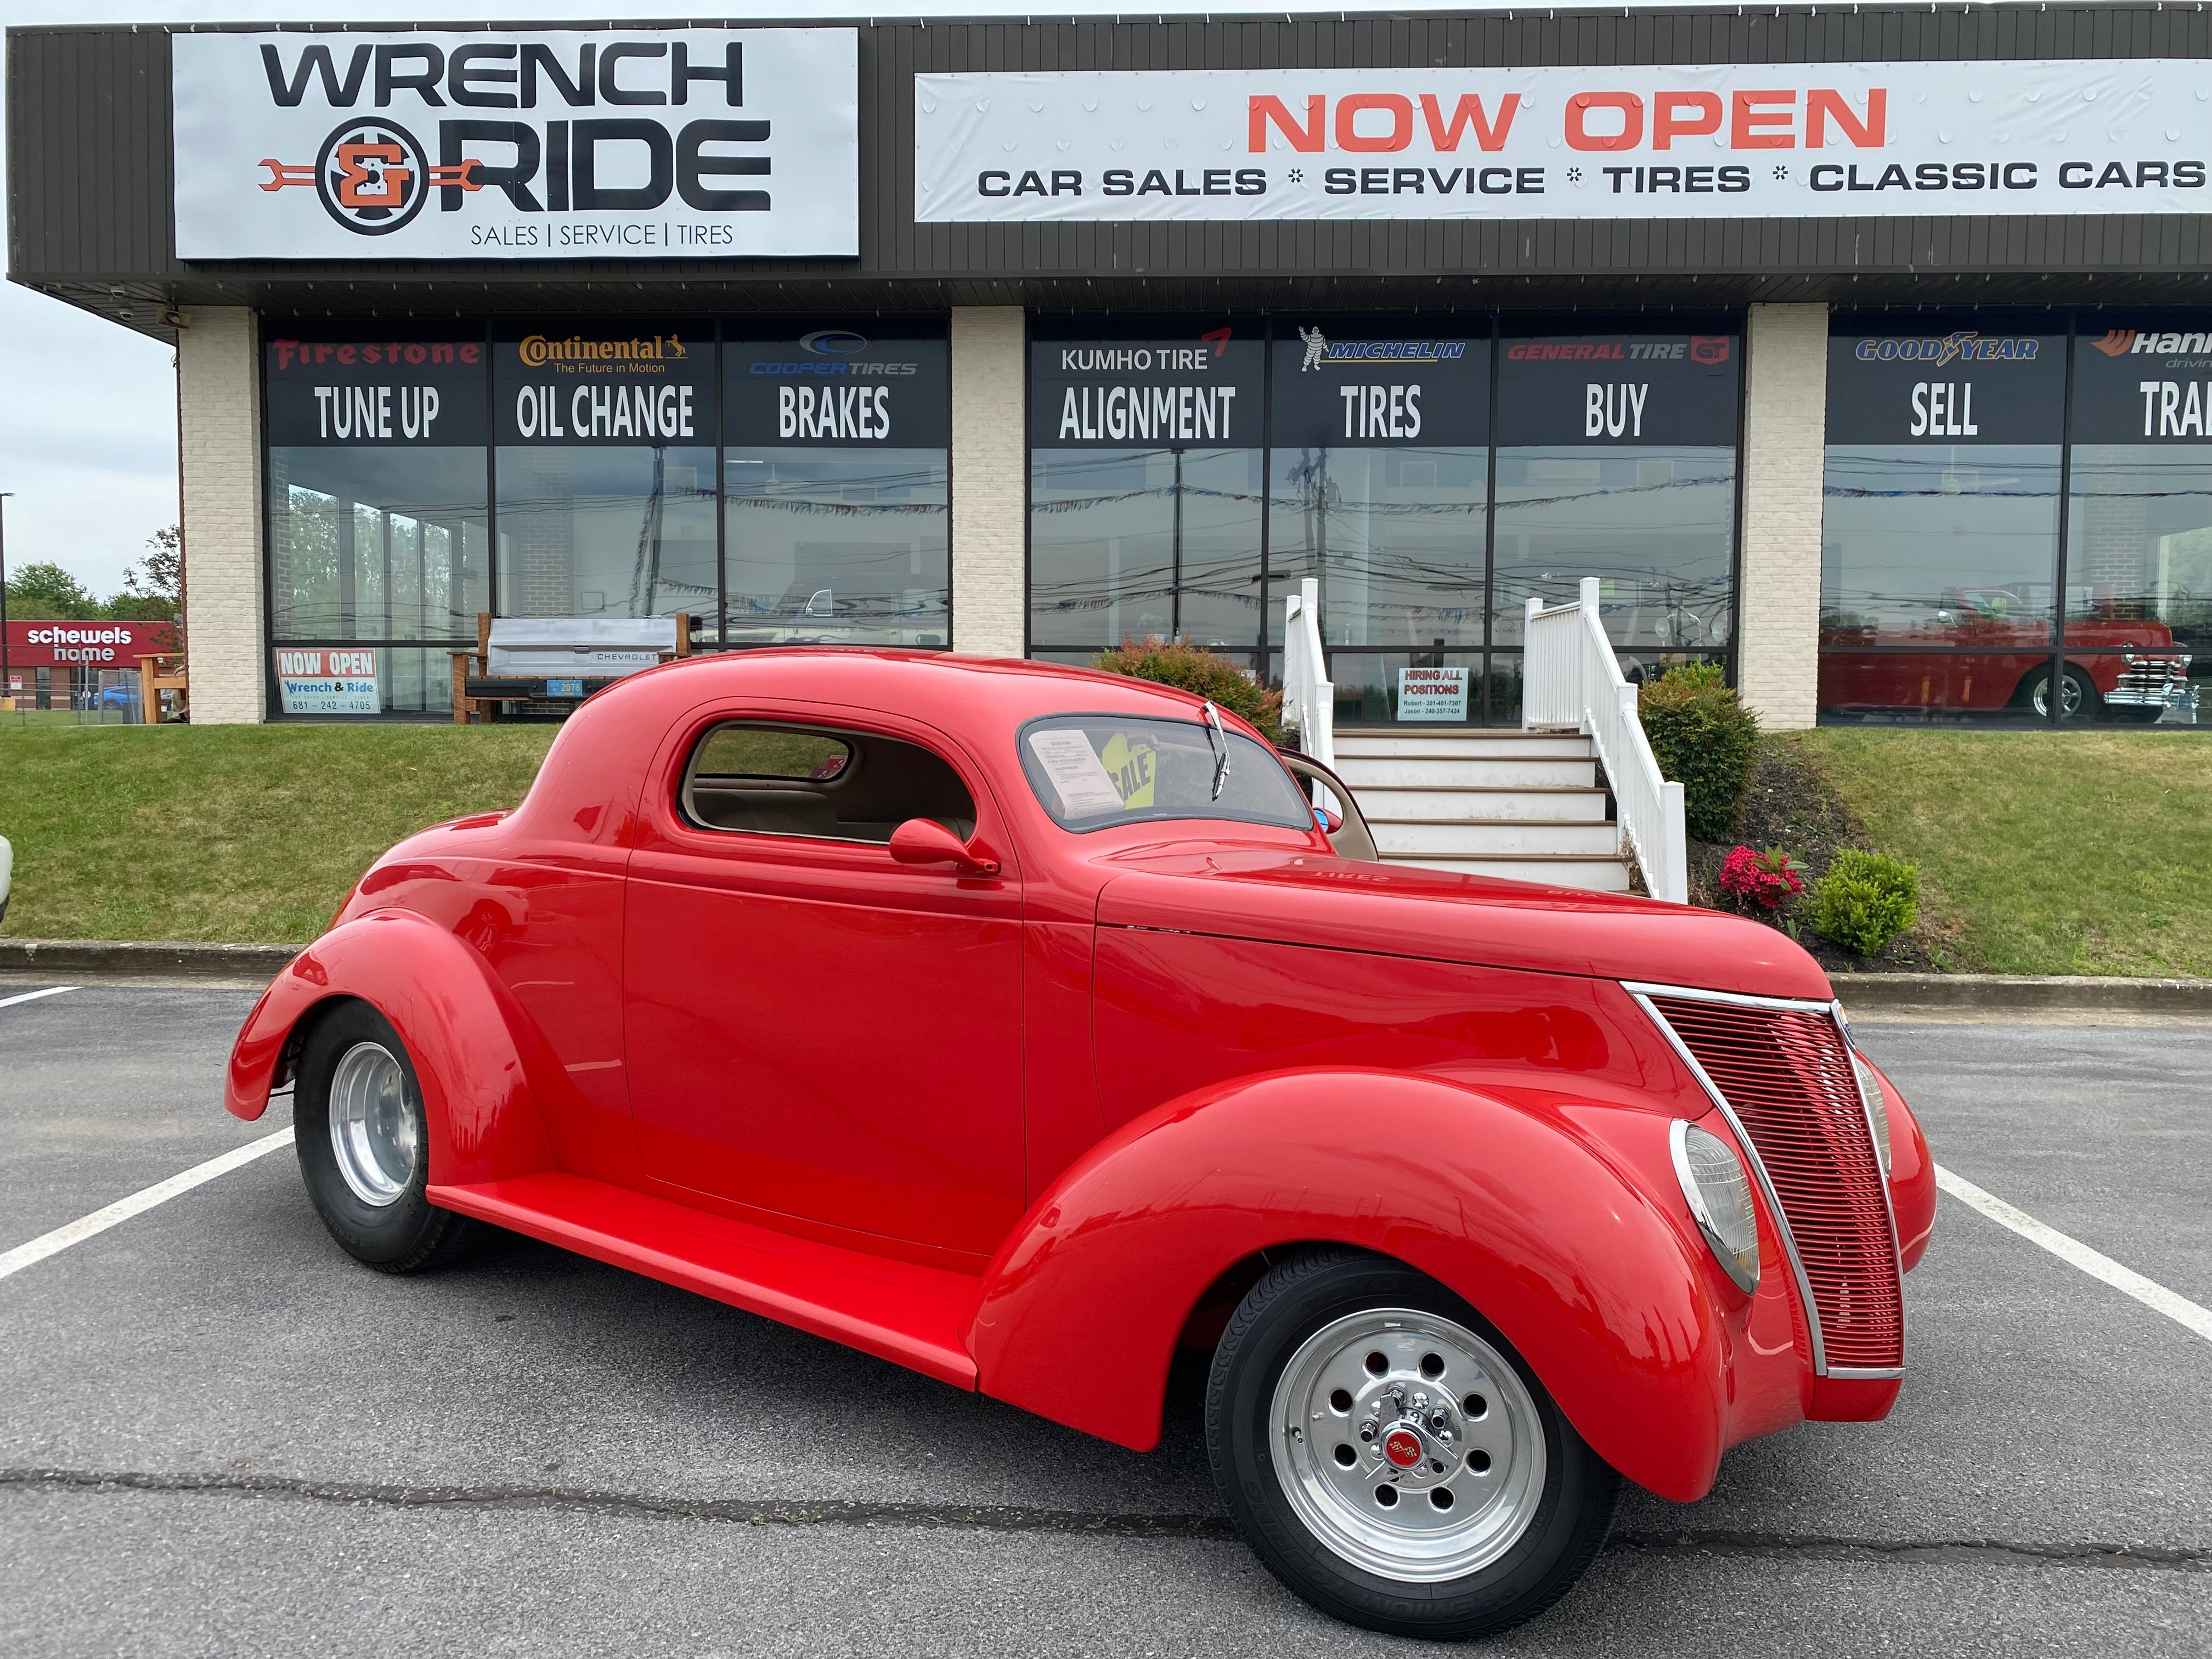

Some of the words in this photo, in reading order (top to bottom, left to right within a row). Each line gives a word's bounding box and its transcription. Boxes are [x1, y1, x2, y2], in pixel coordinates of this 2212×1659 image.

[259, 41, 743, 108] WRENCH
[1248, 93, 1522, 153] NOW
[1564, 88, 1888, 151] OPEN
[439, 118, 771, 212] RIDE
[978, 170, 1082, 196] CAR
[1102, 168, 1268, 196] SALES
[1324, 167, 1546, 195] SERVICE
[1603, 165, 1751, 193] TIRES
[1809, 162, 2038, 191] CLASSIC
[2058, 161, 2207, 189] CARS
[471, 224, 538, 246] SALES
[560, 224, 656, 246] SERVICE
[678, 223, 733, 246] TIRES
[272, 339, 479, 370] Firestone
[519, 334, 664, 366] Continental
[1062, 349, 1152, 370] KUMHO
[1156, 349, 1208, 370] TIRE
[1328, 342, 1465, 359] MICHELIN
[1508, 344, 1624, 360] GENERAL
[1629, 343, 1688, 360] TIRE
[1856, 338, 2039, 361] GOODYEAR
[554, 363, 575, 373] The
[578, 363, 613, 373] Future
[617, 363, 625, 373] in
[629, 363, 665, 373] Motion
[314, 386, 392, 439] TUNE
[402, 386, 439, 439] UP
[517, 385, 563, 438] OIL
[571, 385, 693, 438] CHANGE
[779, 386, 890, 439] BRAKES
[1059, 386, 1236, 439] ALIGNMENT
[1340, 384, 1421, 438] TIRES
[1585, 383, 1649, 437] BUY
[1911, 382, 1978, 436] SELL
[28, 626, 132, 644] schewels
[54, 644, 115, 661] home
[280, 652, 321, 675] NOW
[329, 652, 373, 675] OPEN
[285, 680, 332, 694] Wrench
[334, 681, 343, 692] &
[347, 681, 373, 692] Ride
[1405, 670, 1440, 680] HIRING
[1442, 670, 1463, 680] ALL
[1404, 684, 1459, 695] POSITIONS
[293, 701, 308, 710] 681
[321, 701, 337, 710] 242
[349, 701, 370, 710] 4705
